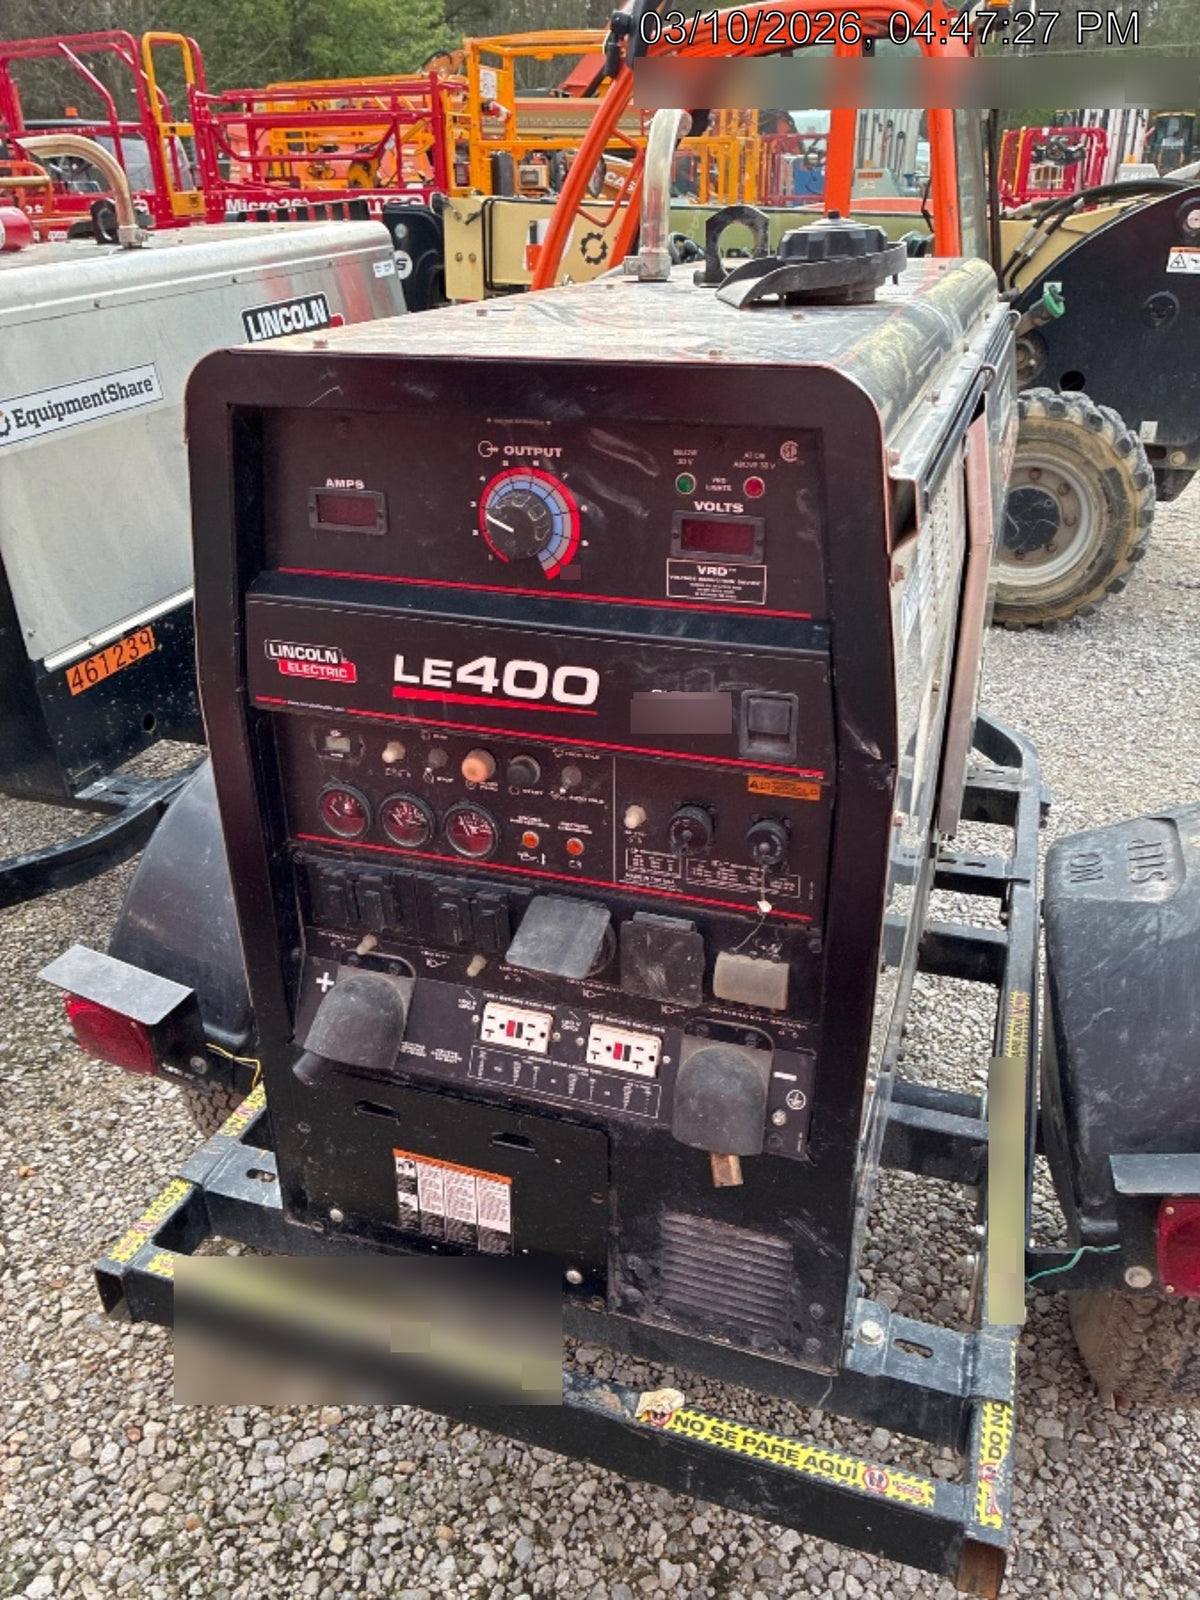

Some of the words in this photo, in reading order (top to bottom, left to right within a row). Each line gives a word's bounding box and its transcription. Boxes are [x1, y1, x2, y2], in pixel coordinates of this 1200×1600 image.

[246, 298, 328, 342] LINCOLN
[11, 378, 153, 428] EquipmentShare
[503, 445, 563, 457] OUTPUT
[325, 478, 365, 490] AMPS
[693, 501, 744, 513] VOLTS
[72, 630, 153, 689] 461239
[269, 643, 338, 664] LINCOLN
[287, 661, 348, 678] ELECTRIC
[393, 654, 600, 705] LE400
[1069, 852, 1104, 883] NO
[673, 1414, 705, 1433] NO
[710, 1426, 738, 1444] SE
[742, 1436, 801, 1465] PARE
[989, 1430, 1002, 1460] DO
